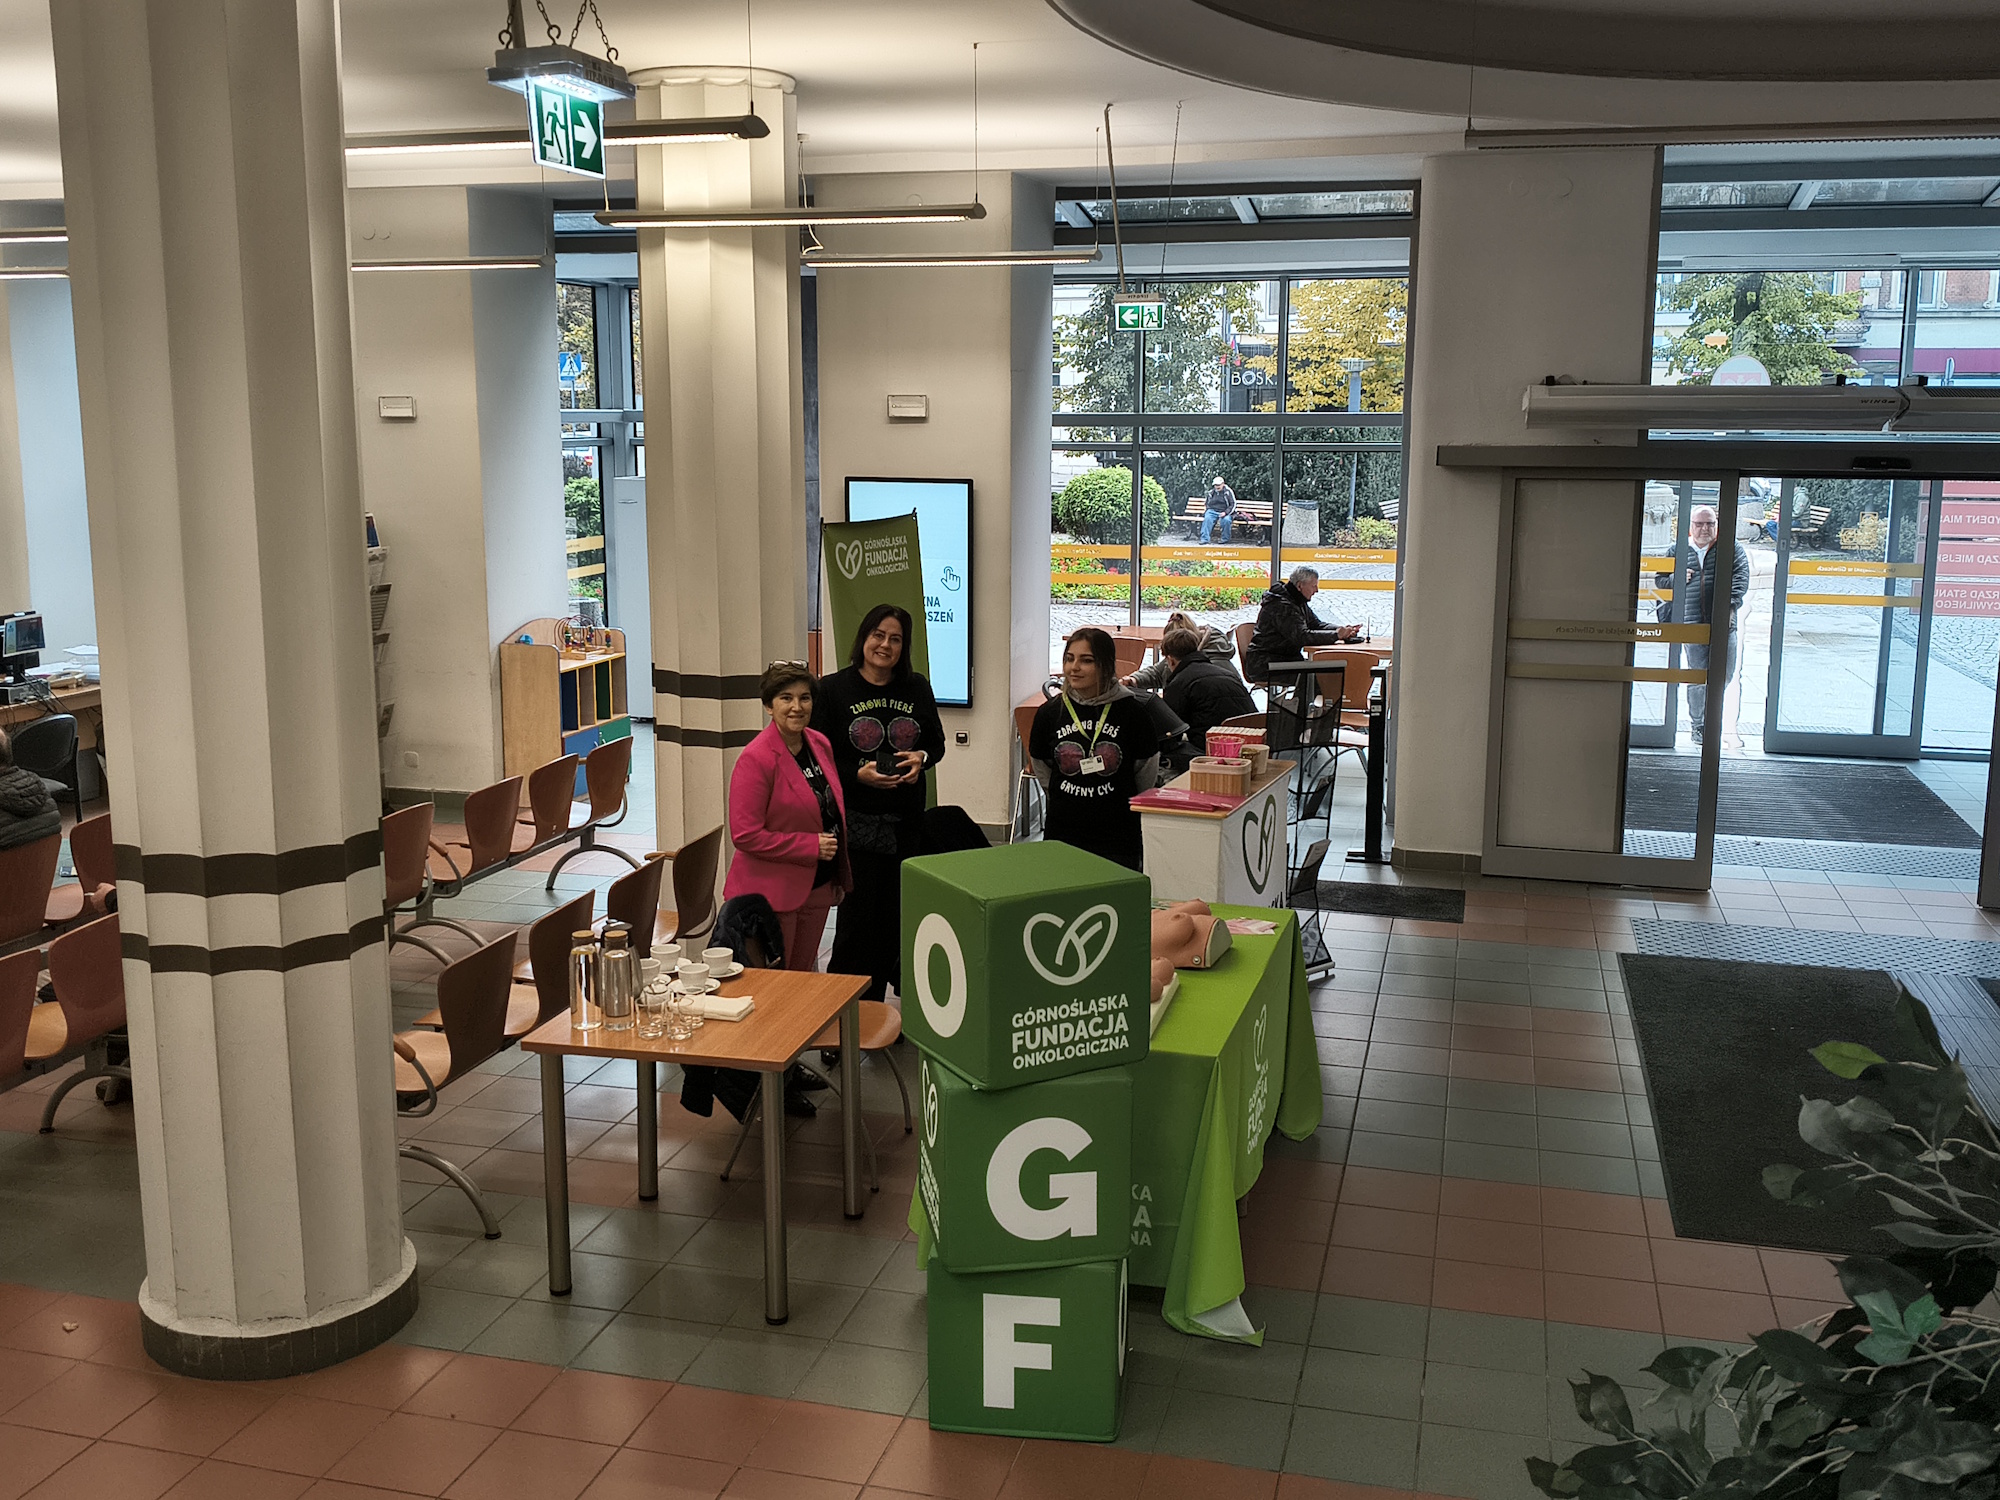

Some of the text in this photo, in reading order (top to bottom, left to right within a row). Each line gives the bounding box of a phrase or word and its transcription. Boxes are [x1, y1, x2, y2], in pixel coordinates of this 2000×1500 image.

[864, 535, 908, 550] GÓRNOŚLĄSKA
[864, 547, 909, 566] FUNDACJA
[866, 565, 910, 577] ONKOLOGICZNA
[1097, 782, 1114, 796] CYC
[914, 913, 968, 1038] O
[1012, 993, 1129, 1029] GÓRNOŚLĄSKA
[1012, 1012, 1129, 1054] FUNDACJA
[1013, 1035, 1130, 1070] ONKOLOGICZNA
[986, 1116, 1098, 1241] G
[982, 1293, 1061, 1409] F
